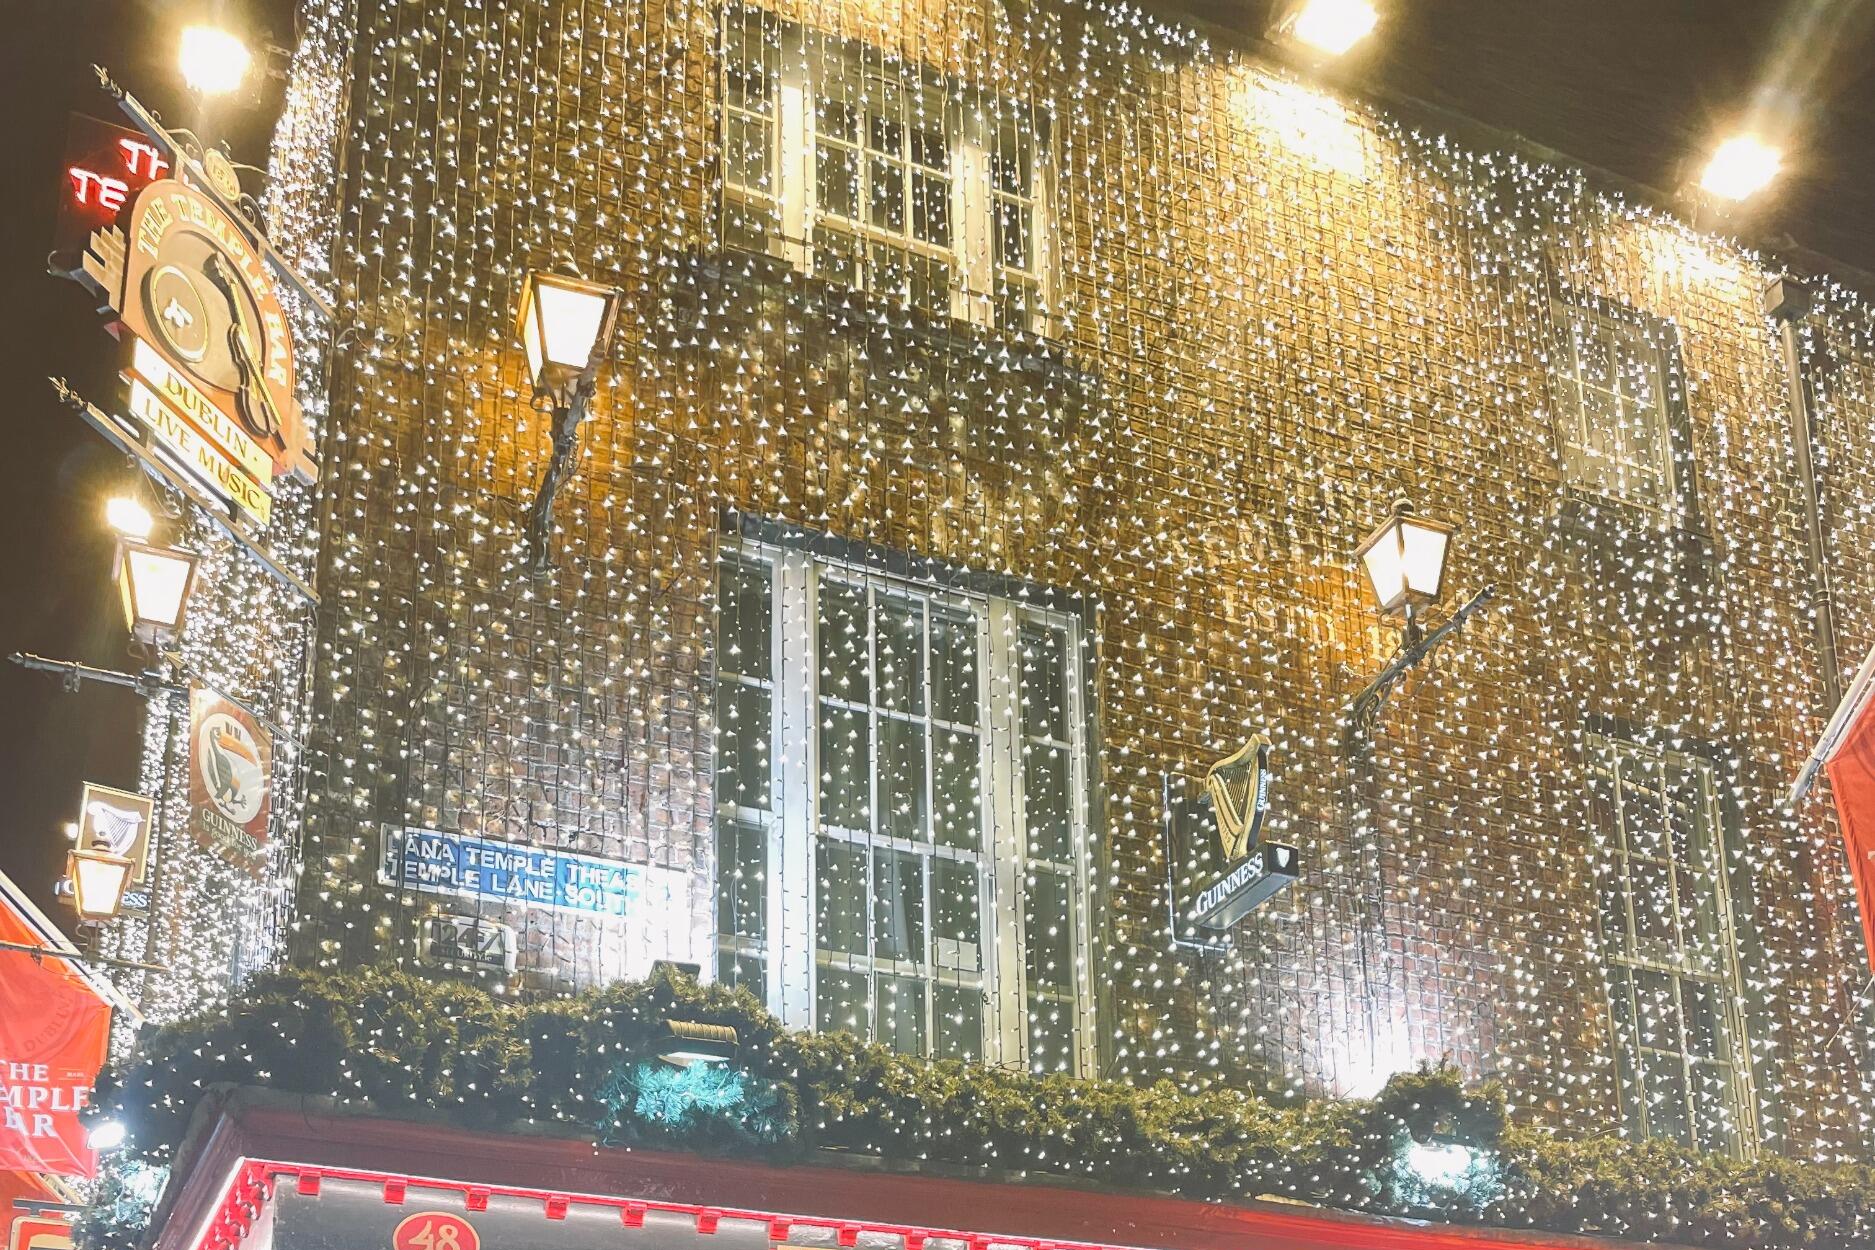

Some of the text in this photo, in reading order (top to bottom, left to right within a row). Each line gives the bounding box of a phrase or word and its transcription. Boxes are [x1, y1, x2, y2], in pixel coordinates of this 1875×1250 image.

[137, 193, 288, 387] THE TEMPLE BAR
[164, 371, 248, 459] DUBLIN
[145, 398, 261, 510] LIVE MUSIC
[1256, 768, 1267, 812] GUINNESS
[203, 808, 257, 850] GUINNESS
[386, 857, 481, 889] TEMPLE
[492, 874, 555, 899] LANE
[466, 845, 556, 877] TEMPLE
[1196, 852, 1264, 915] GUINNESS
[0, 1060, 48, 1082] HE
